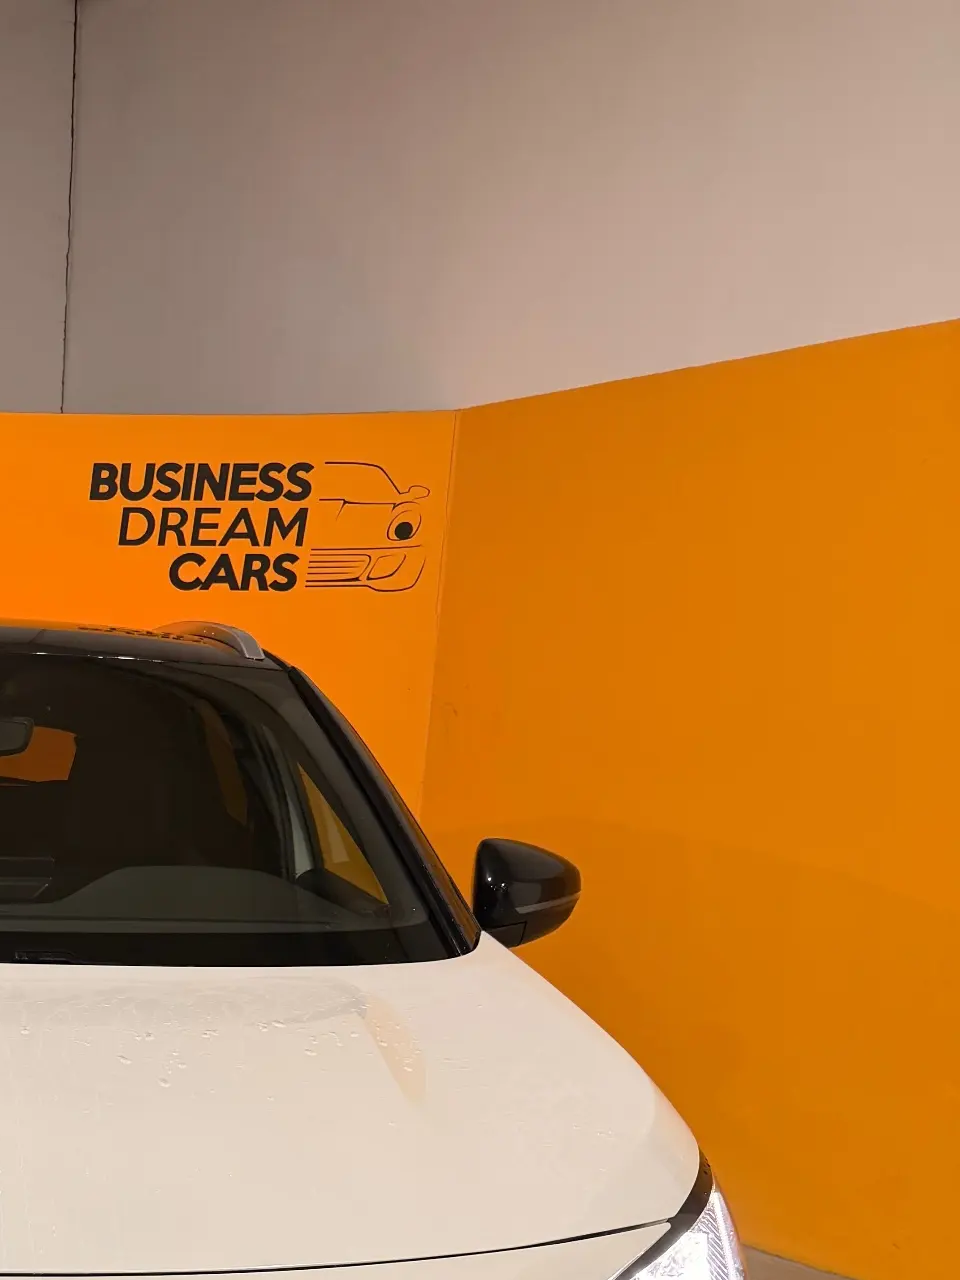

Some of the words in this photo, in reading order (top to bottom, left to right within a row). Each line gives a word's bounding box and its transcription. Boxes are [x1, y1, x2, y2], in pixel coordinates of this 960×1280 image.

[89, 462, 315, 501] BUSINESS
[118, 507, 309, 546] DREAM
[169, 553, 300, 591] CARS
